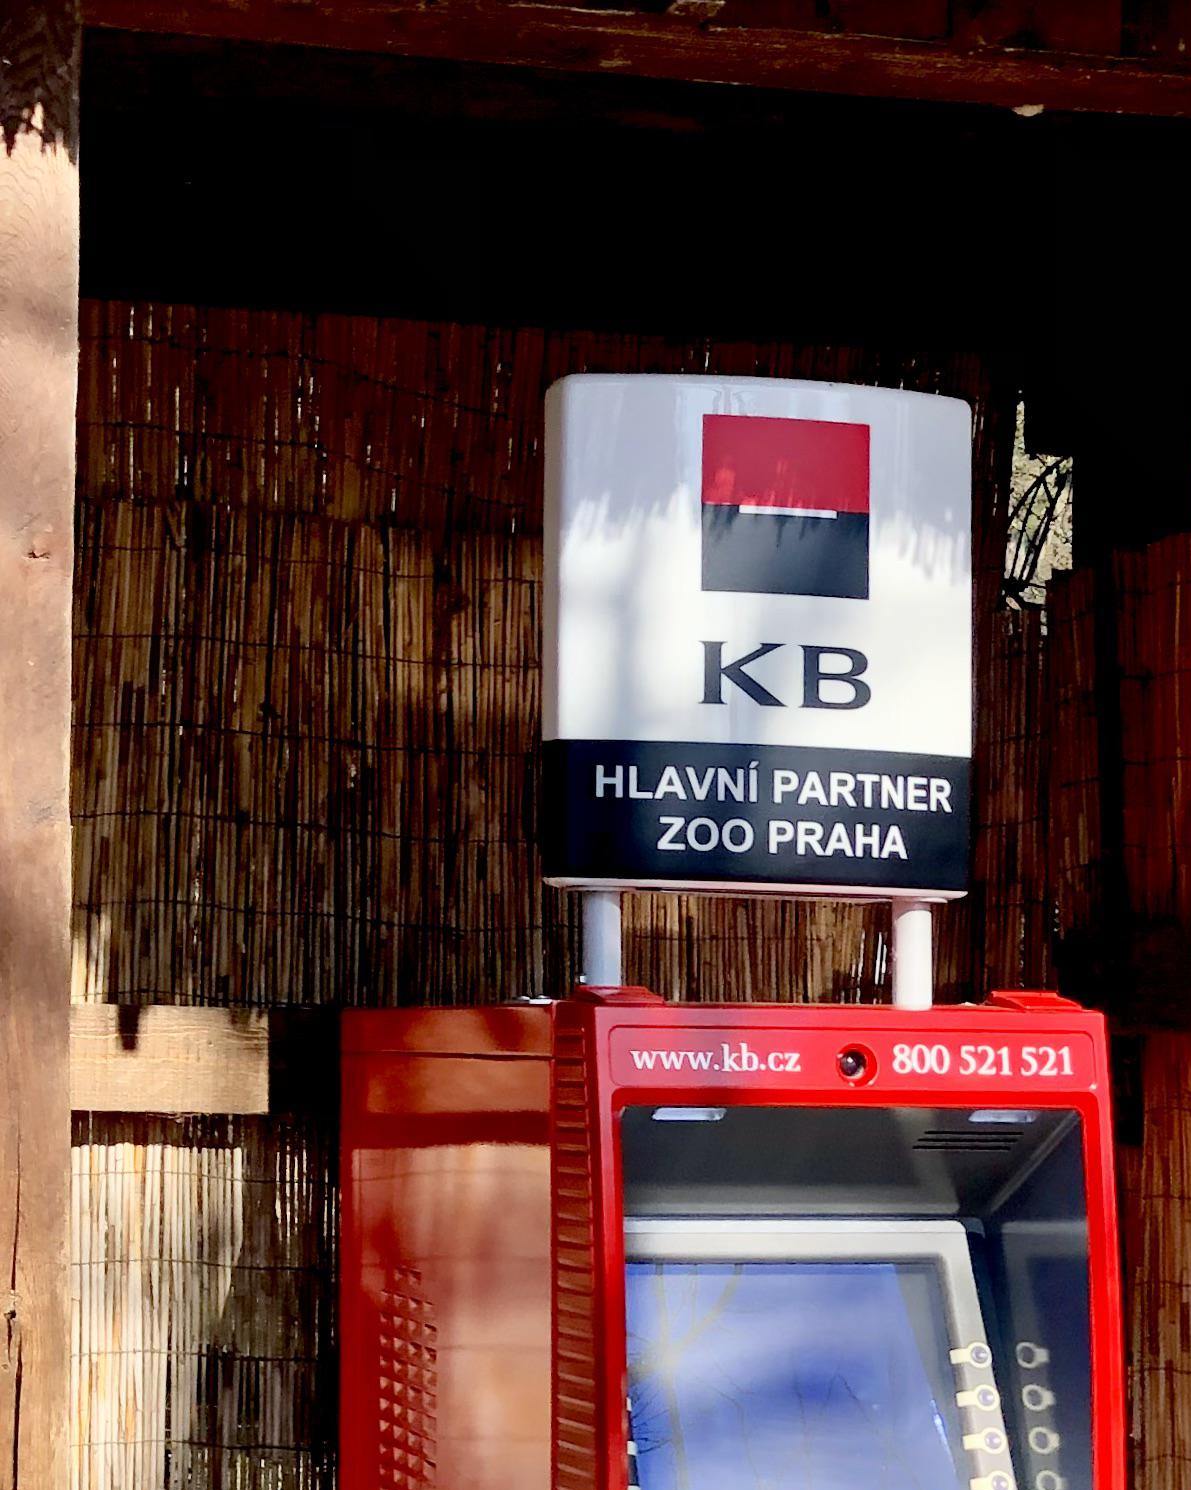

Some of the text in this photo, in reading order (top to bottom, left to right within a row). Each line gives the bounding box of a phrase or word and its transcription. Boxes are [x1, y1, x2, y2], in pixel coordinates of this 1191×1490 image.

[698, 640, 872, 710] KB
[595, 761, 953, 813] HLAVNÍ PARTNER
[656, 816, 909, 860] ZOO PRAHA
[629, 1042, 801, 1074] www.kb.cz
[892, 1043, 1075, 1076] 800 521 521
